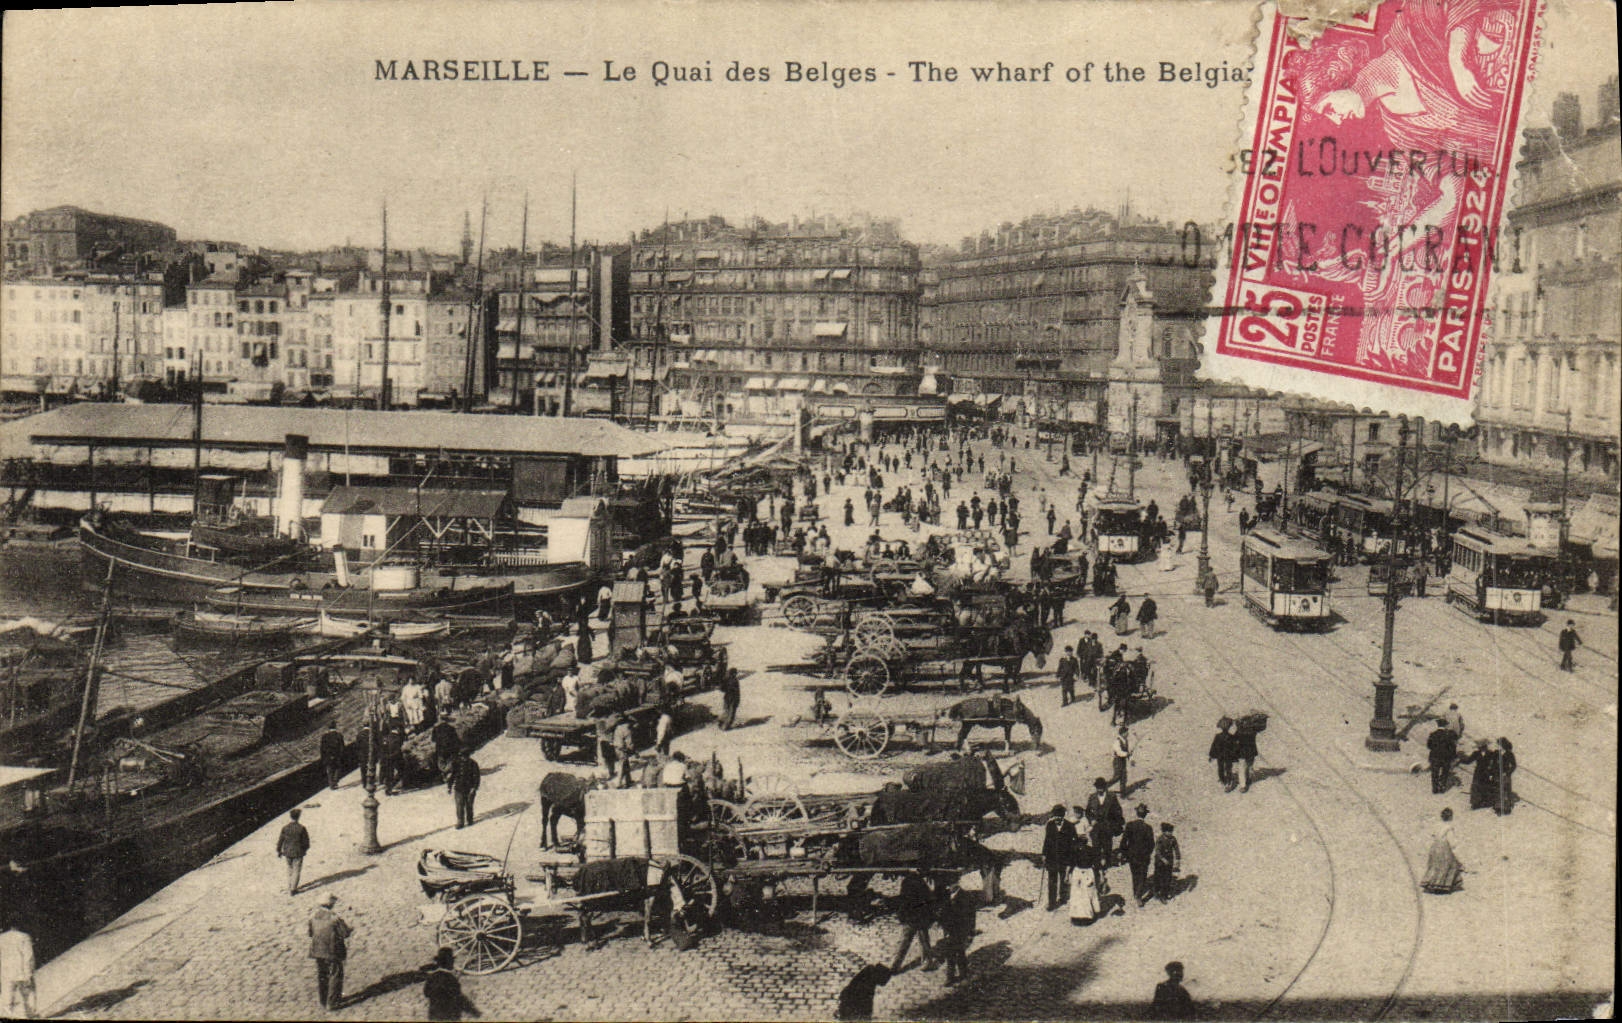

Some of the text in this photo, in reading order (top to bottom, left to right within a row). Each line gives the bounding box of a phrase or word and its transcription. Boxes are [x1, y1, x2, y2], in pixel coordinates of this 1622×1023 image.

[1238, 289, 1303, 349] 25
[1301, 295, 1324, 353] POSTES
[1321, 294, 1345, 357] FRANCE
